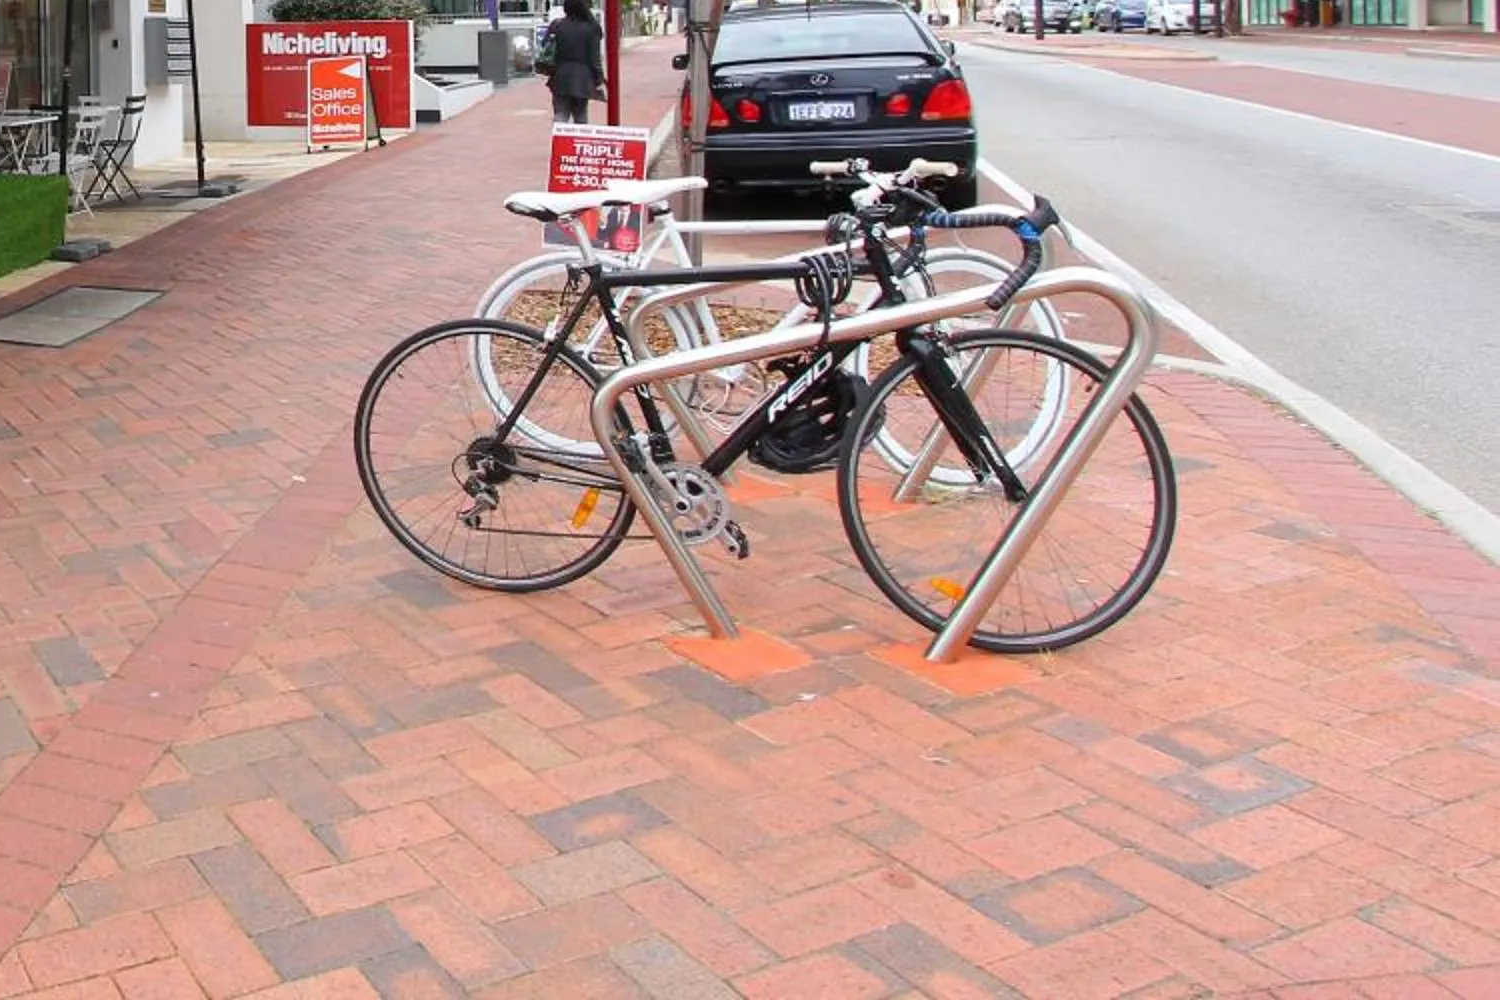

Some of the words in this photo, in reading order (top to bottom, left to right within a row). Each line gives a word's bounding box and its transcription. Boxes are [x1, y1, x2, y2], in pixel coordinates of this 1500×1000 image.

[311, 87, 357, 101] Sales
[312, 102, 362, 118] Office
[573, 143, 624, 158] TRIPLE
[572, 174, 609, 188] $30,0
[768, 351, 833, 424] REID
